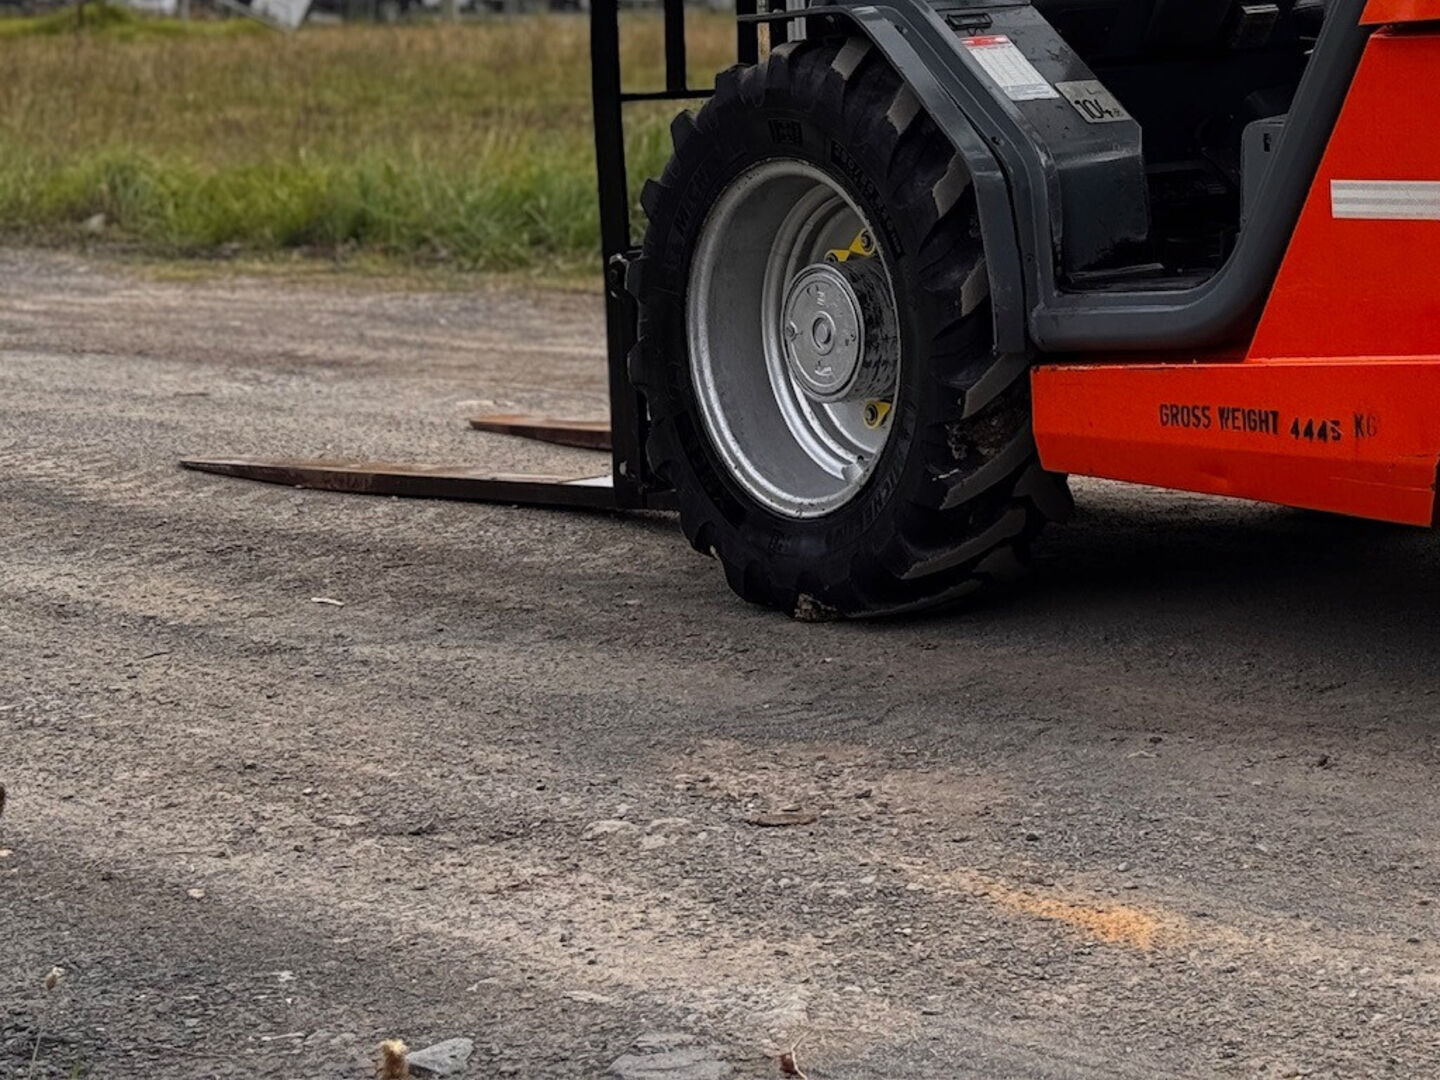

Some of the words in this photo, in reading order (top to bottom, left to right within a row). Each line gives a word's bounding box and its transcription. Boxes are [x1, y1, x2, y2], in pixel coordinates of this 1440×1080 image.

[1159, 403, 1212, 429] GROSS
[1217, 406, 1280, 436] WEIGHT
[1290, 416, 1343, 443] 4445
[1353, 411, 1379, 439] KG
